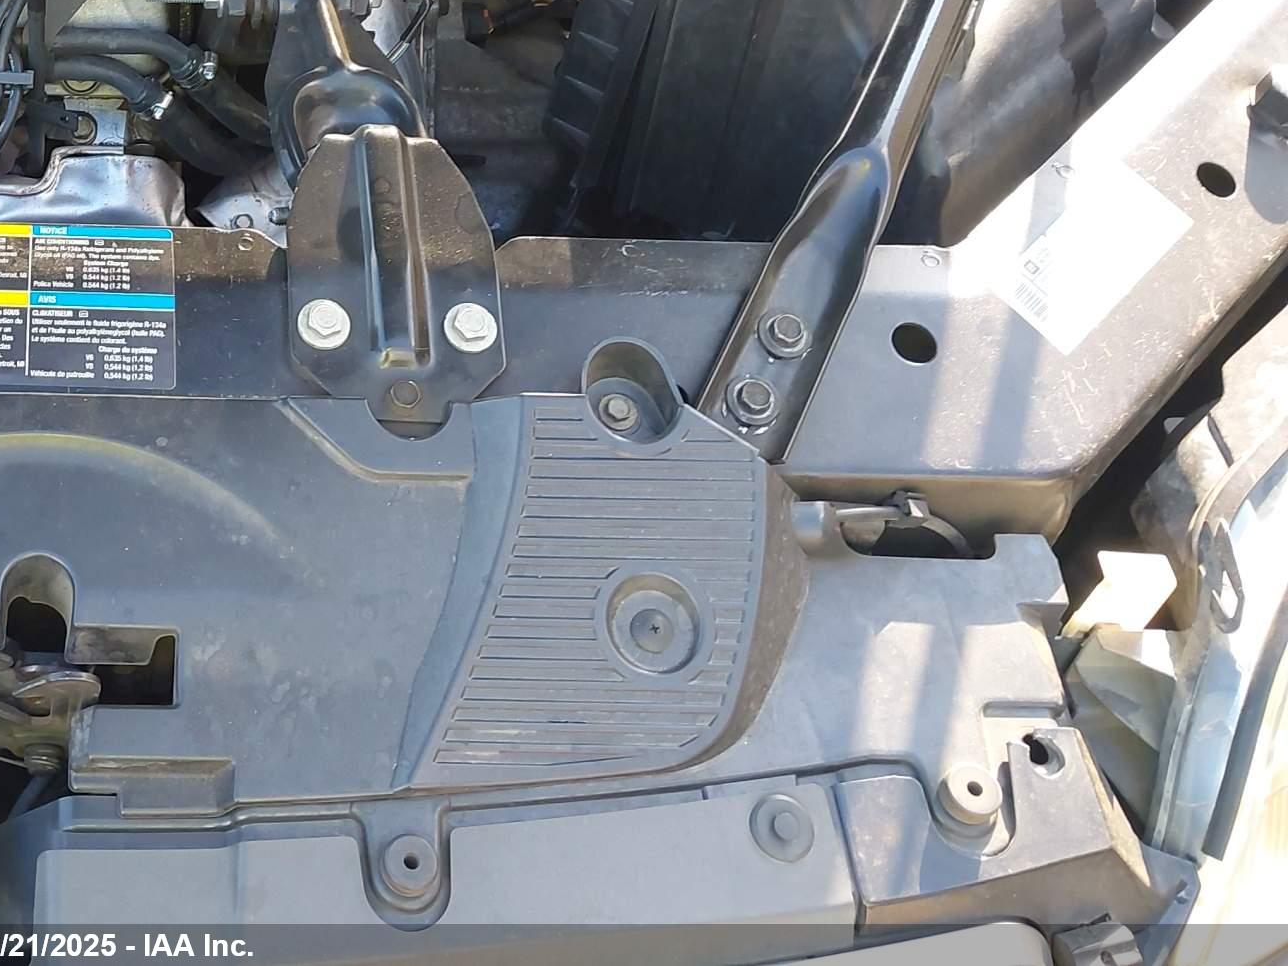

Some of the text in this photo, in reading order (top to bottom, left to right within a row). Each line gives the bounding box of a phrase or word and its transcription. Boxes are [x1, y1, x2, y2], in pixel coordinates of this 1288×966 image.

[39, 226, 67, 234] NOTICE
[38, 295, 57, 304] AVIS
[98, 345, 121, 354] Charge
[122, 355, 131, 363] kg
[122, 363, 131, 372] kg
[122, 372, 131, 381] kg
